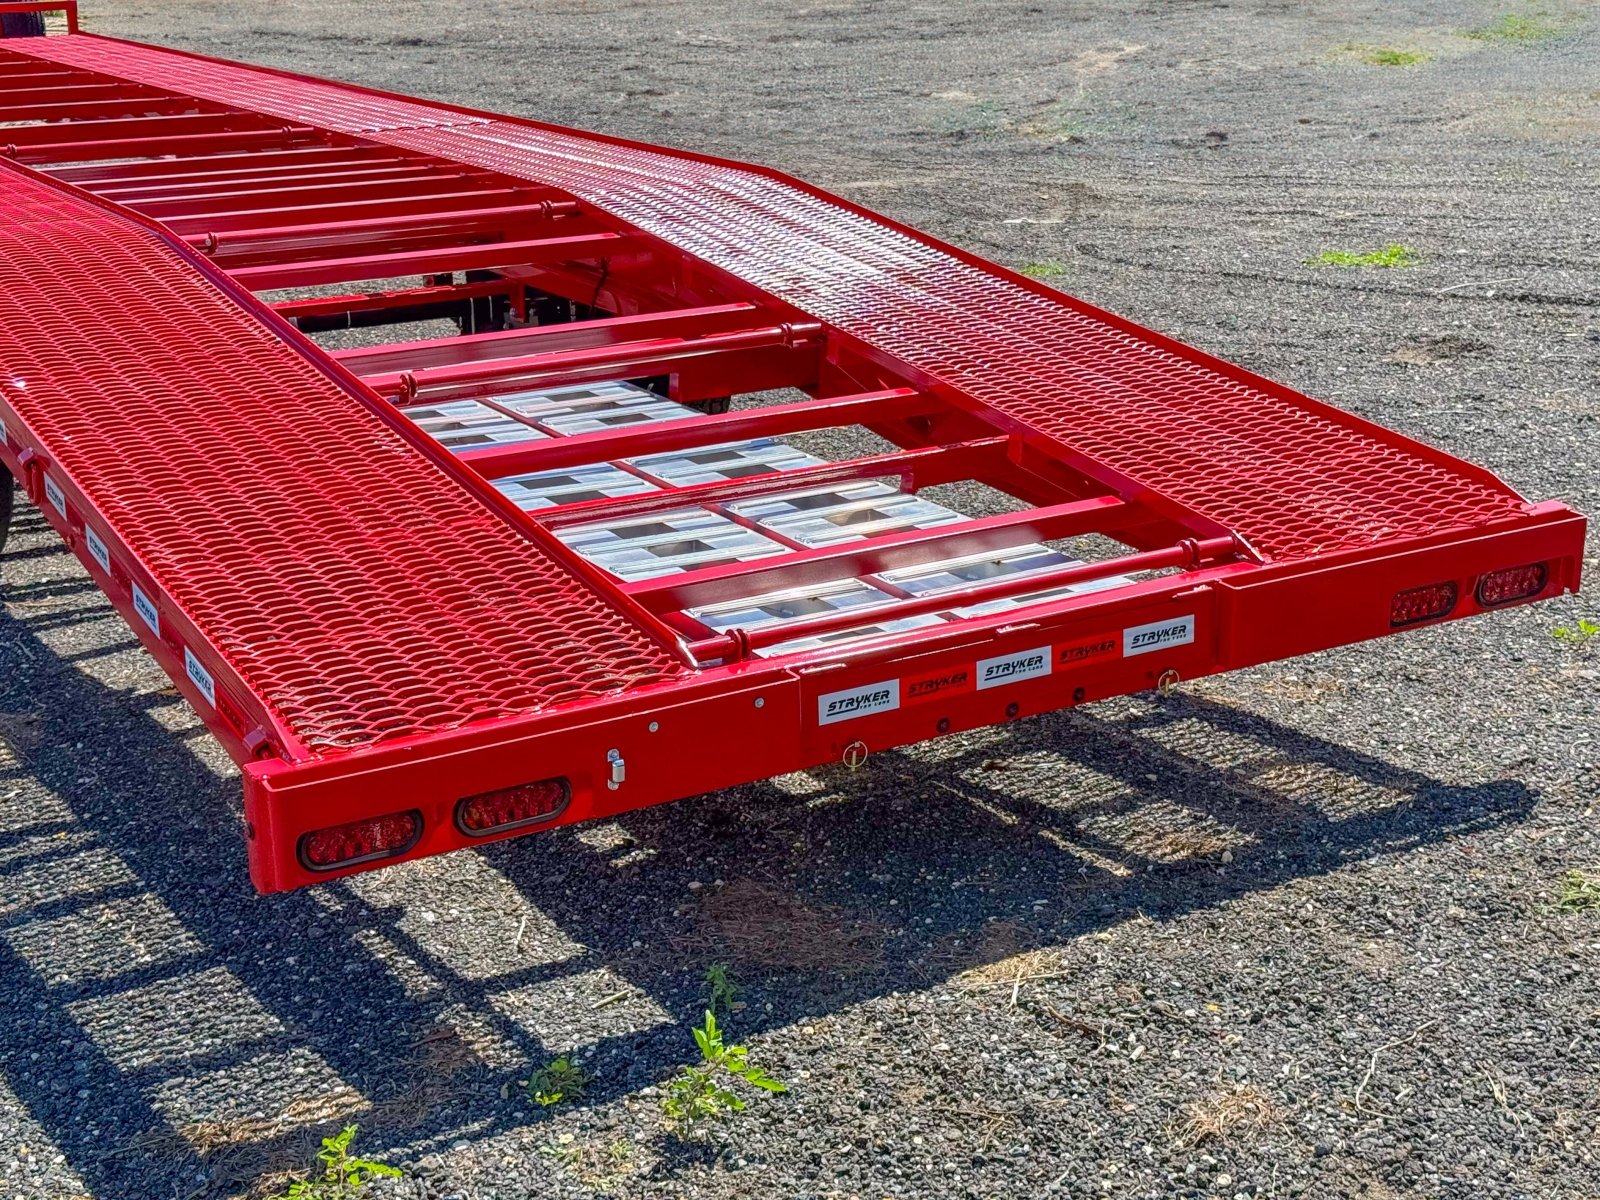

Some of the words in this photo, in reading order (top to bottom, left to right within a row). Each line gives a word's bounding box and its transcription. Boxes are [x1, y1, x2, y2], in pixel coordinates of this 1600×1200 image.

[1131, 625, 1187, 649] STRYKER
[1059, 640, 1116, 664] STRYKER
[984, 655, 1043, 681] STRYKER
[907, 672, 968, 698] STRYKER
[826, 690, 890, 717] STRYKER
